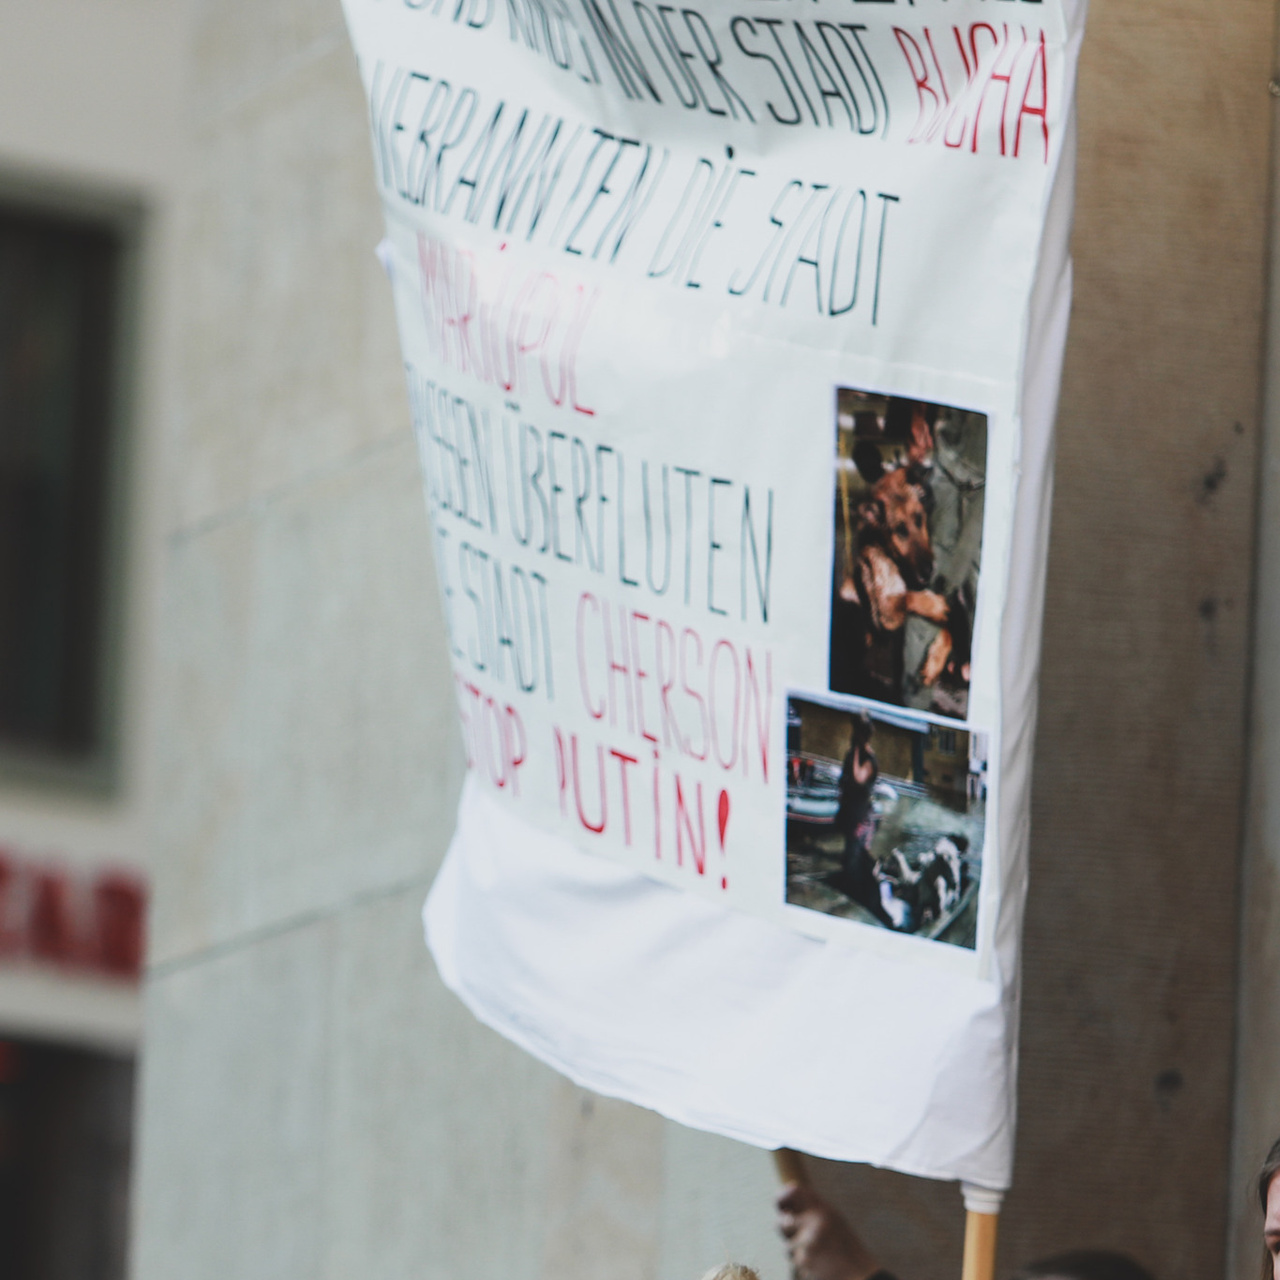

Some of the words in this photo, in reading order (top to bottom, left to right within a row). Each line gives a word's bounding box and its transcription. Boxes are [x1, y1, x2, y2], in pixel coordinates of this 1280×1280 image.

[634, 1, 756, 123] DER
[730, 16, 889, 140] STADT
[728, 179, 900, 326] STADT
[458, 540, 555, 702] STADT
[575, 590, 774, 785] CHERSON
